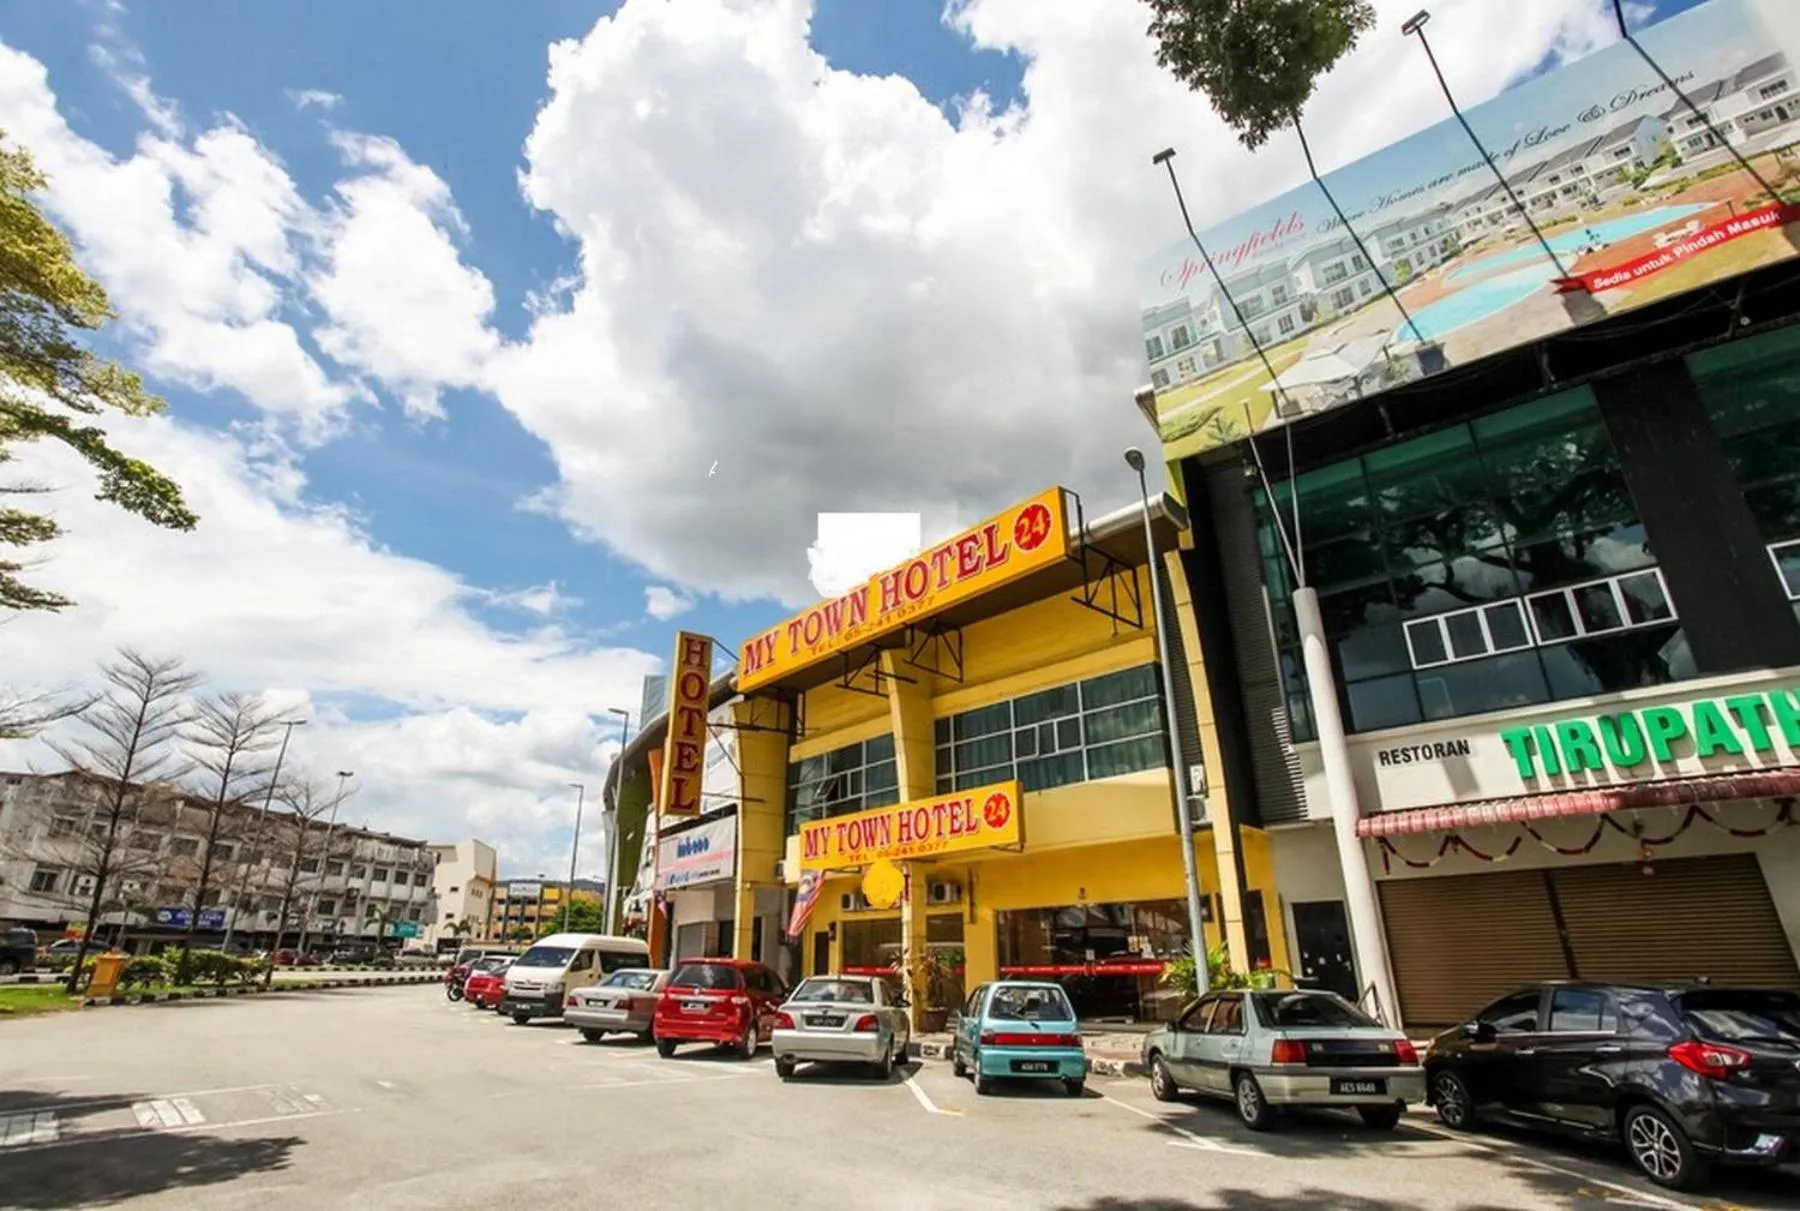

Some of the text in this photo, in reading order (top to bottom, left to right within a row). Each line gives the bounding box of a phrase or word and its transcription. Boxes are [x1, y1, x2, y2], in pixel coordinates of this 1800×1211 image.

[1161, 210, 1305, 290] Springfields
[1592, 210, 1781, 289] Sedia untuk Pindah Masuk
[743, 508, 1047, 676] MY TOWN HOTEL 24
[670, 636, 708, 811] HOTEL
[1378, 738, 1471, 767] RESTORAN
[804, 825, 831, 859] MY
[836, 814, 892, 853] TOWN
[898, 798, 978, 843] HOTEL
